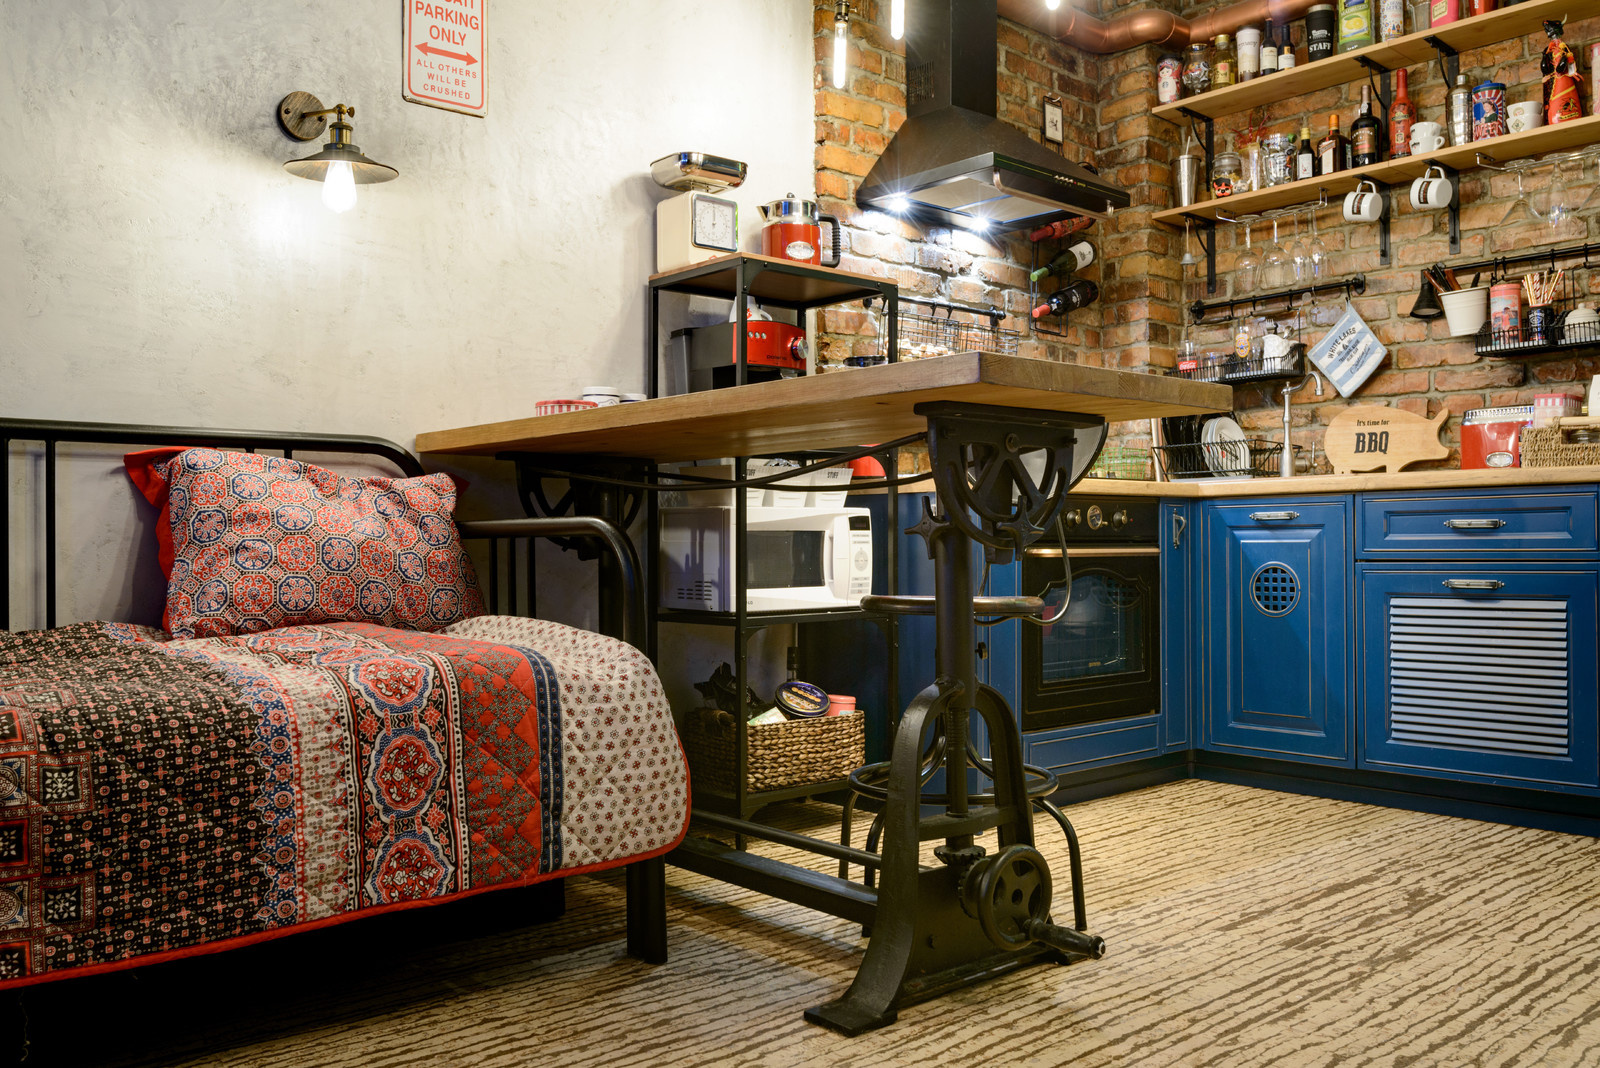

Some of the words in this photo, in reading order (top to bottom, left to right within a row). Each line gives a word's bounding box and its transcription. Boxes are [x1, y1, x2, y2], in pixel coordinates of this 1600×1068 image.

[415, 1, 479, 30] PARKING
[429, 25, 466, 46] ONLY
[1309, 42, 1332, 53] STAFF
[416, 58, 435, 69] ALL
[438, 63, 477, 79] OTHERS
[427, 72, 451, 84] WILL
[454, 78, 467, 88] BE
[423, 83, 471, 100] CRUSHED
[1327, 338, 1341, 359] WHITE
[1338, 327, 1357, 342] LAKES
[1354, 431, 1390, 455] BBQ
[827, 471, 839, 479] STUFF
